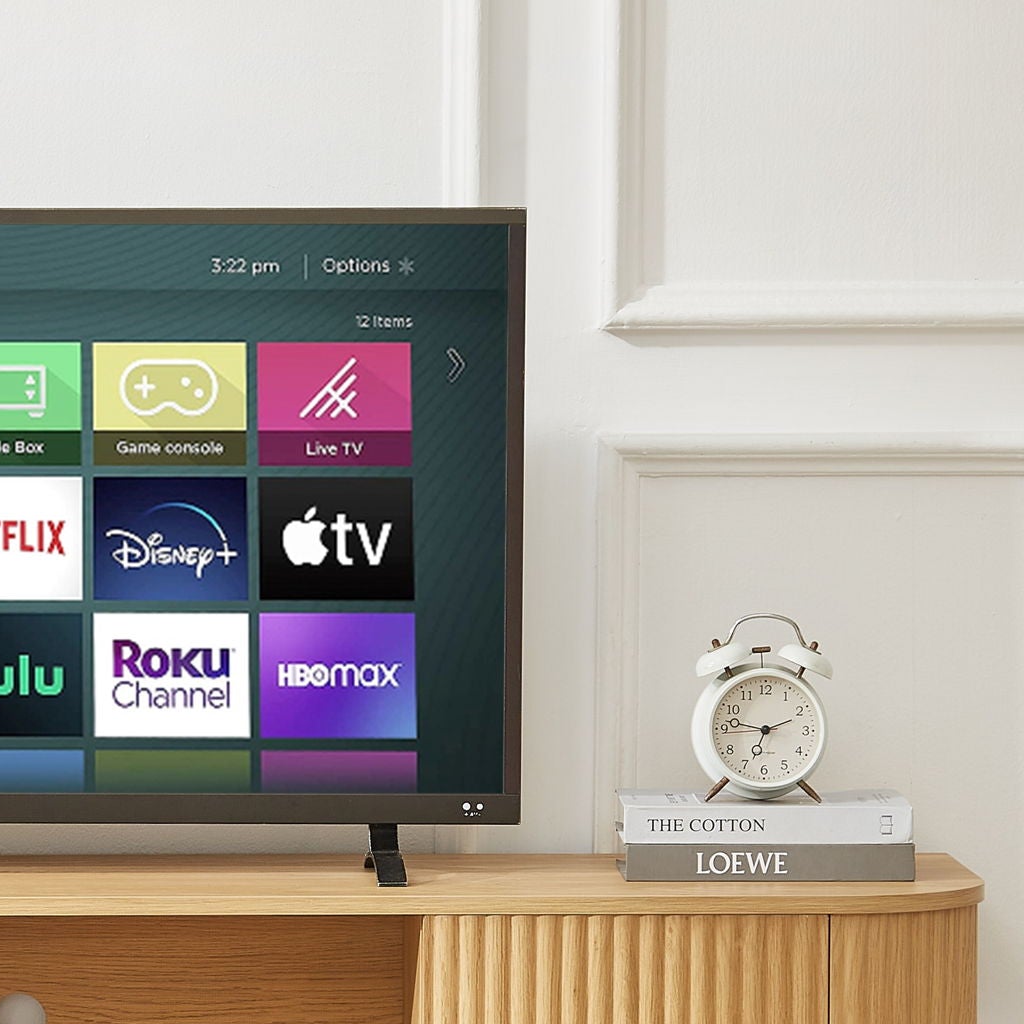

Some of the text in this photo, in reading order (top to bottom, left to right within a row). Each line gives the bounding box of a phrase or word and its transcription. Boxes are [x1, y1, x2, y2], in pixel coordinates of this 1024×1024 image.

[211, 257, 280, 278] 3:22 pm
[322, 256, 391, 277] Options
[355, 314, 370, 328] 12
[14, 440, 45, 454] Box
[115, 440, 225, 456] Game console
[305, 441, 363, 456] Live TV
[330, 513, 392, 566] tv
[112, 680, 230, 709] Channel
[740, 690, 753, 701] 11
[759, 684, 773, 696] 12
[727, 704, 740, 715] 10
[796, 705, 804, 716] 2
[721, 723, 728, 734] 9
[802, 725, 810, 736] 3
[726, 744, 734, 755] 8
[795, 746, 803, 756] 4
[741, 759, 749, 769] 7
[760, 764, 768, 776] 6
[780, 760, 788, 770] 5
[647, 818, 766, 832] THE COTTON
[696, 852, 788, 874] LOEWE
